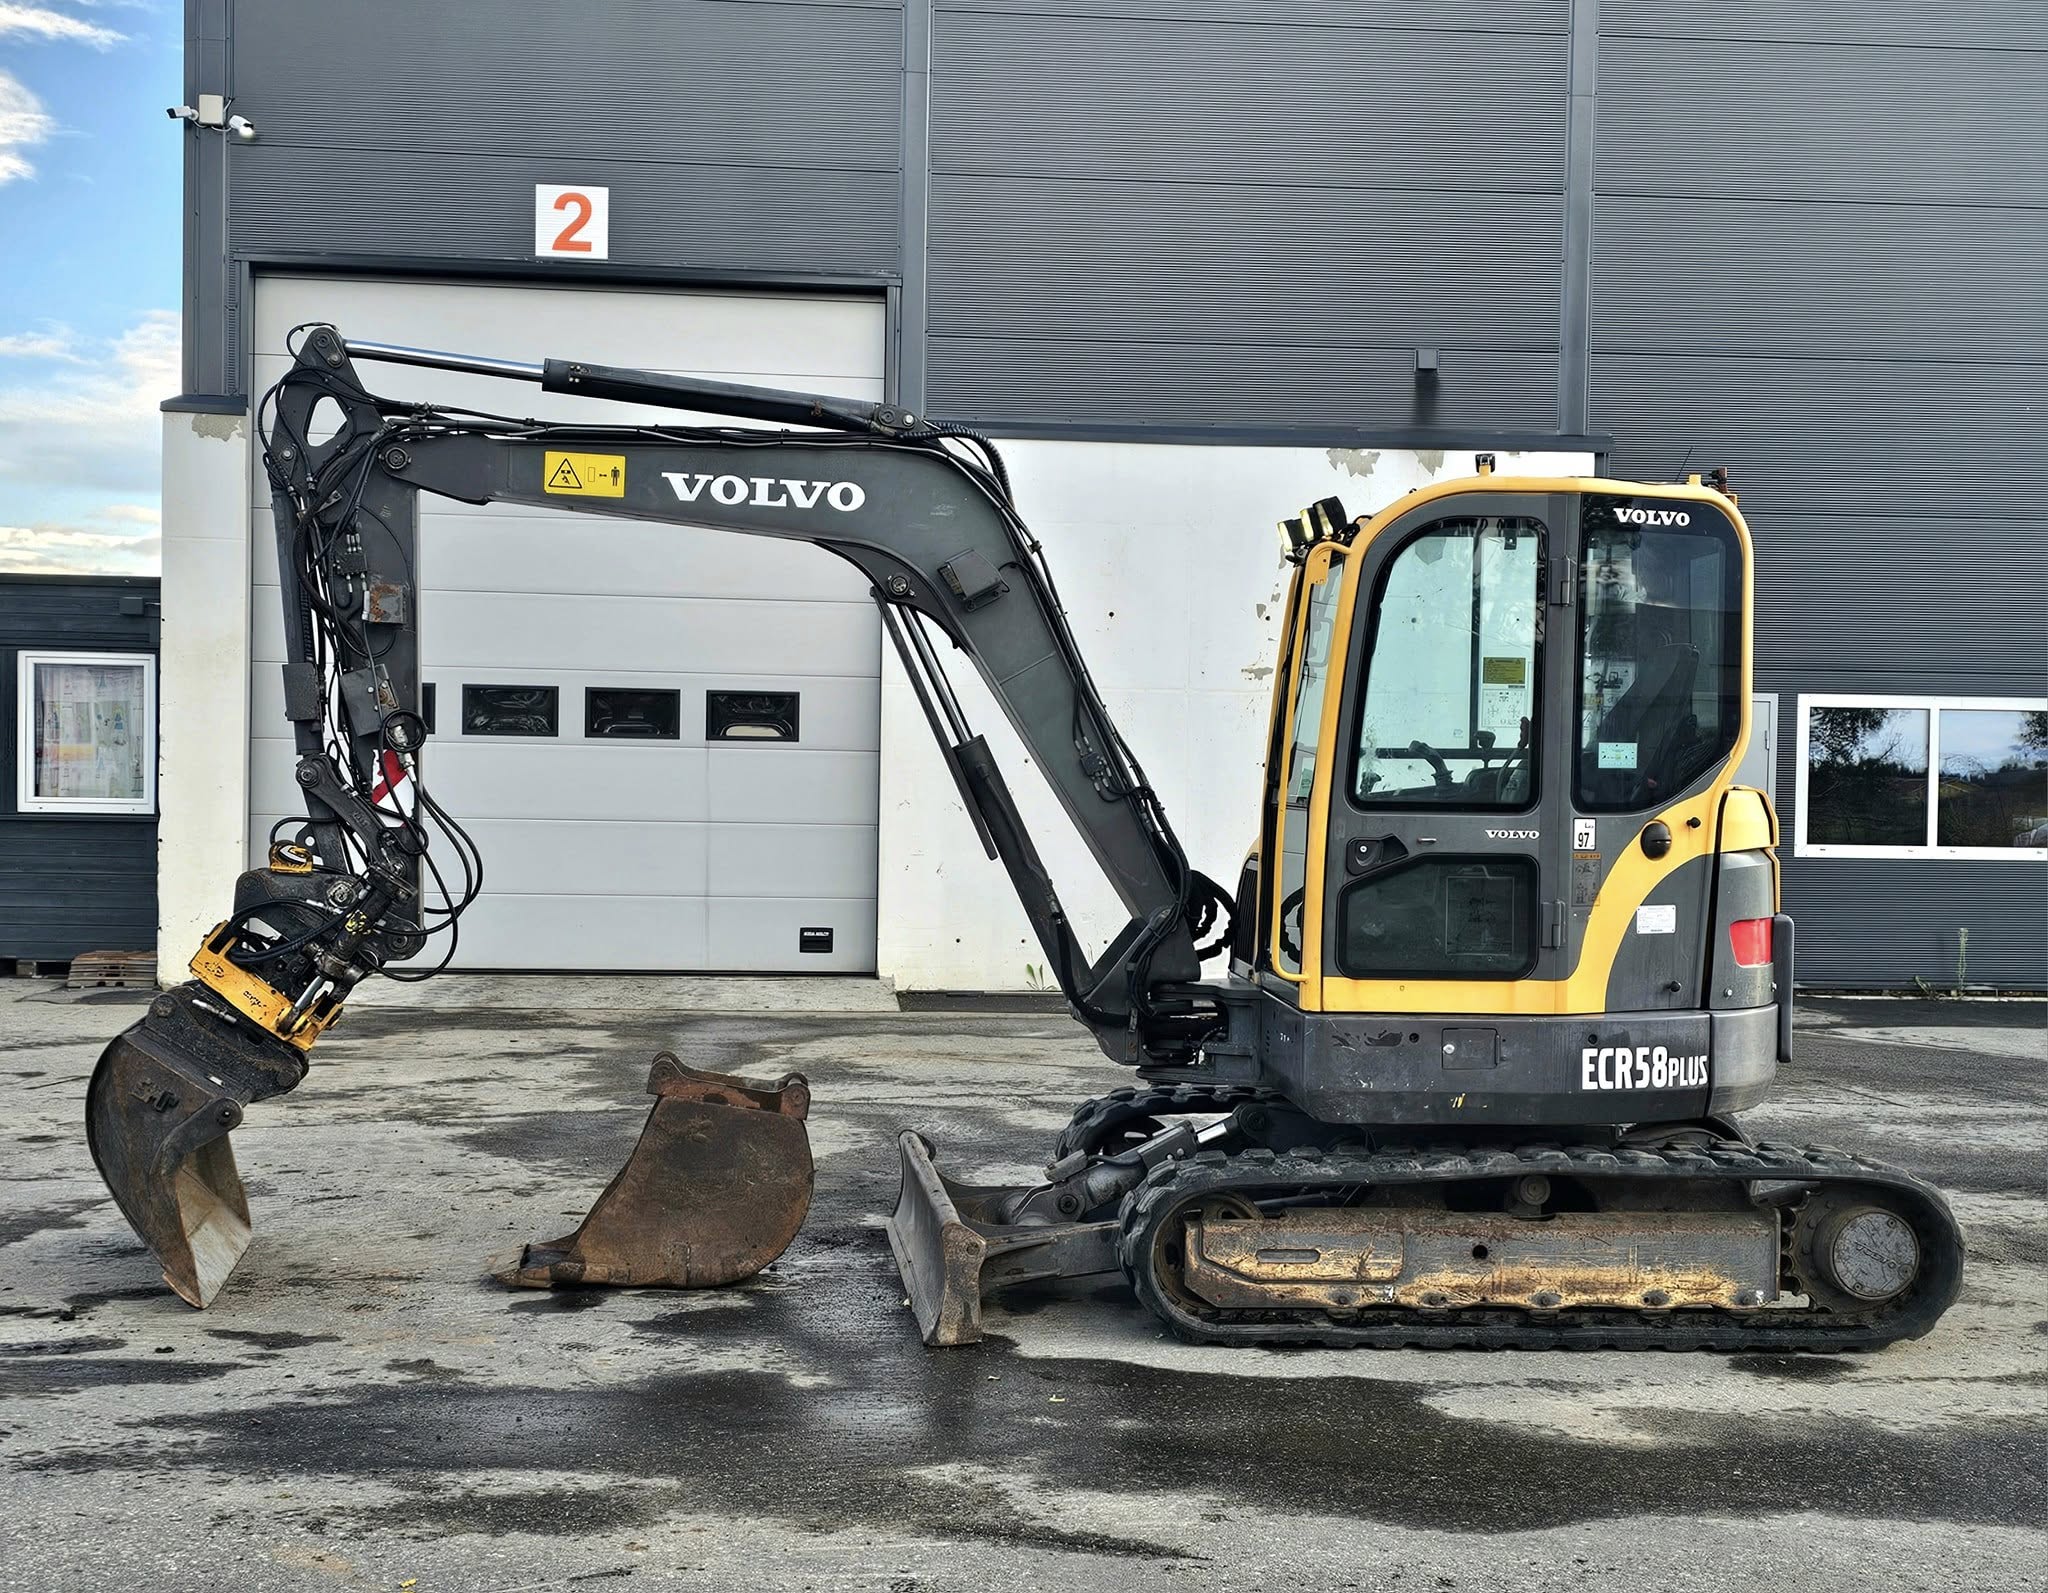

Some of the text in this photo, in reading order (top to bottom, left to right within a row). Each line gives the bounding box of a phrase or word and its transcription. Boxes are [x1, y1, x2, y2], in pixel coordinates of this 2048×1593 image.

[552, 192, 592, 252] 2
[661, 472, 866, 512] VOLVO
[1613, 507, 1690, 527] VOLVO
[1485, 829, 1540, 839] VOLVO
[1577, 832, 1590, 848] 97
